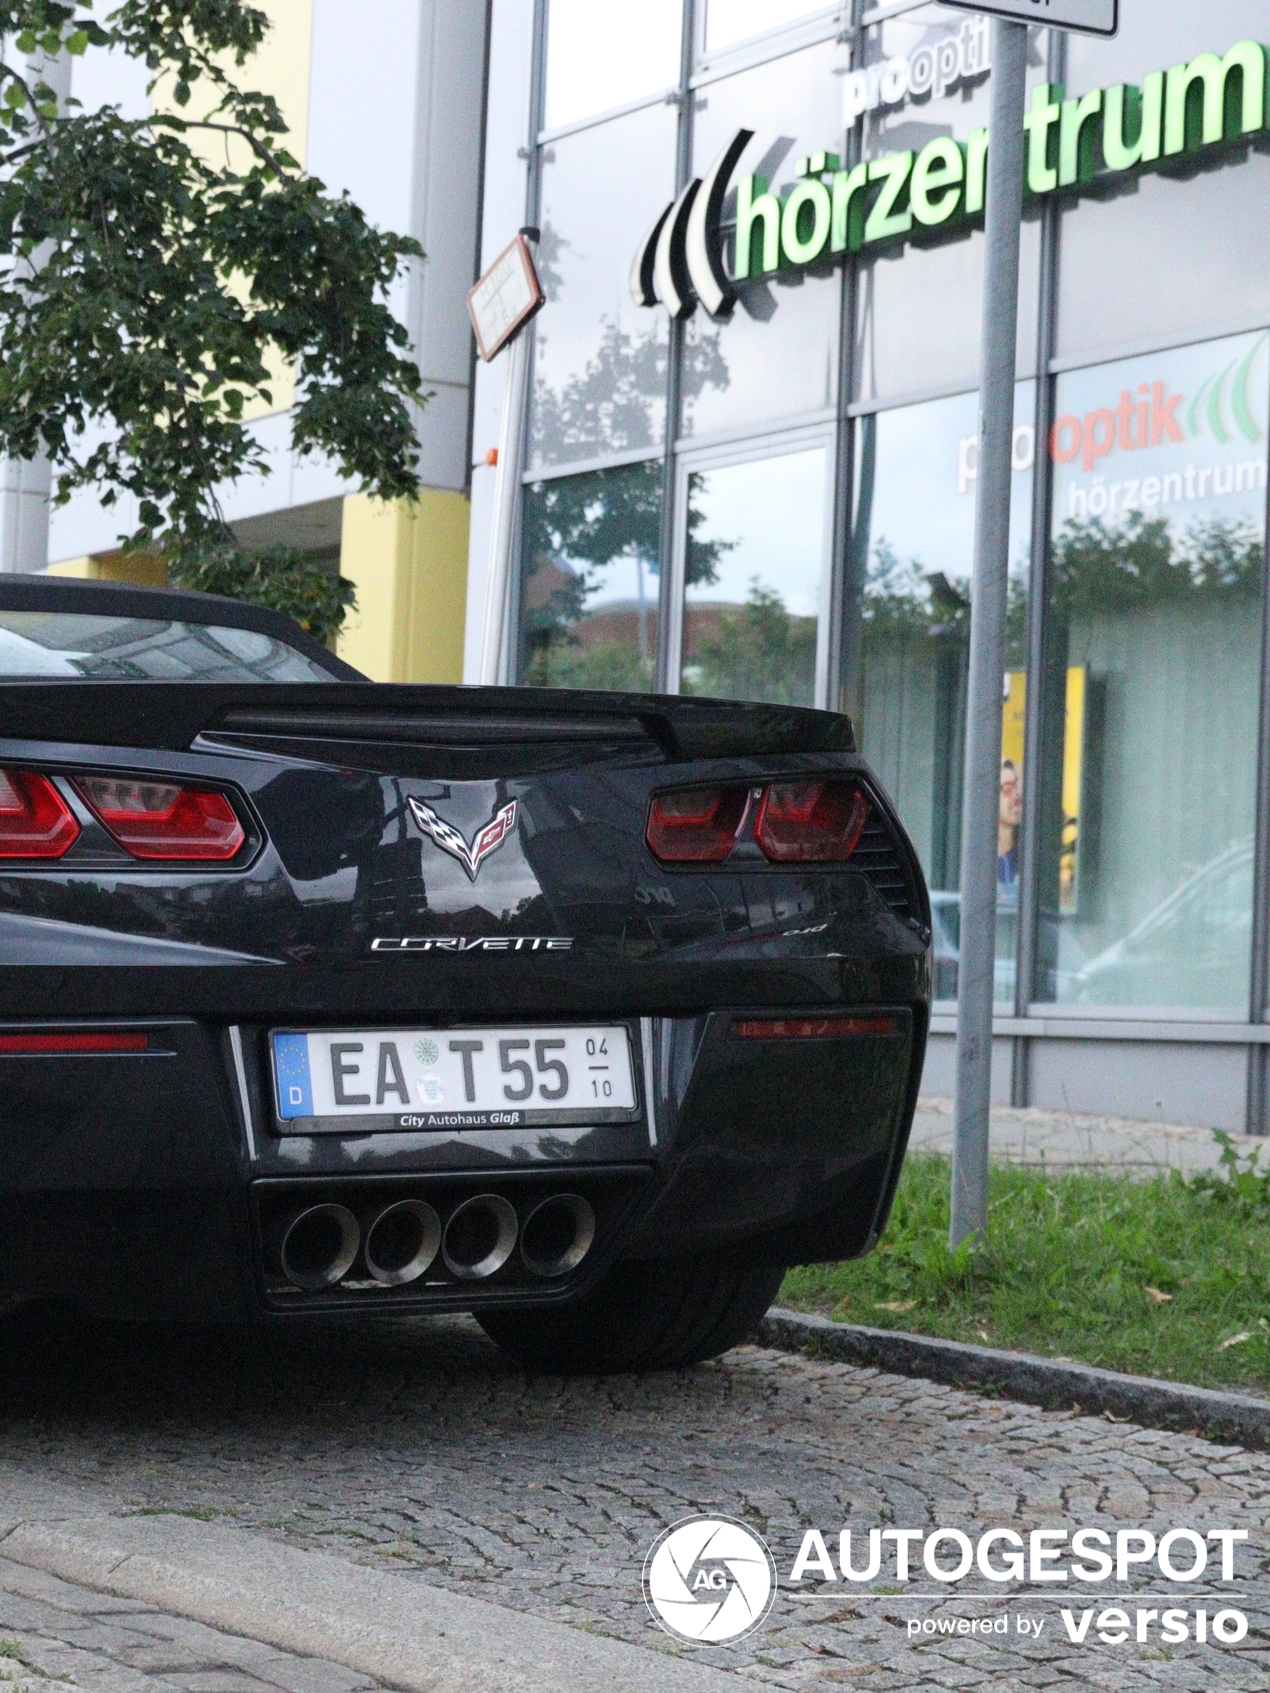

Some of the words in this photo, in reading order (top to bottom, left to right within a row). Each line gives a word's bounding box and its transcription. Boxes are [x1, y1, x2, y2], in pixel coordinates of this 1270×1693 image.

[1050, 380, 1183, 471] optik
[1068, 458, 1267, 518] hörzentrum
[371, 936, 575, 951] CORVETTE
[586, 1038, 609, 1057] 04
[330, 1041, 412, 1106] EA
[289, 1086, 302, 1105] D
[591, 1079, 612, 1099] 10
[400, 1115, 425, 1128] City
[428, 1113, 487, 1125] Autohaus
[490, 1112, 520, 1125] Glaß
